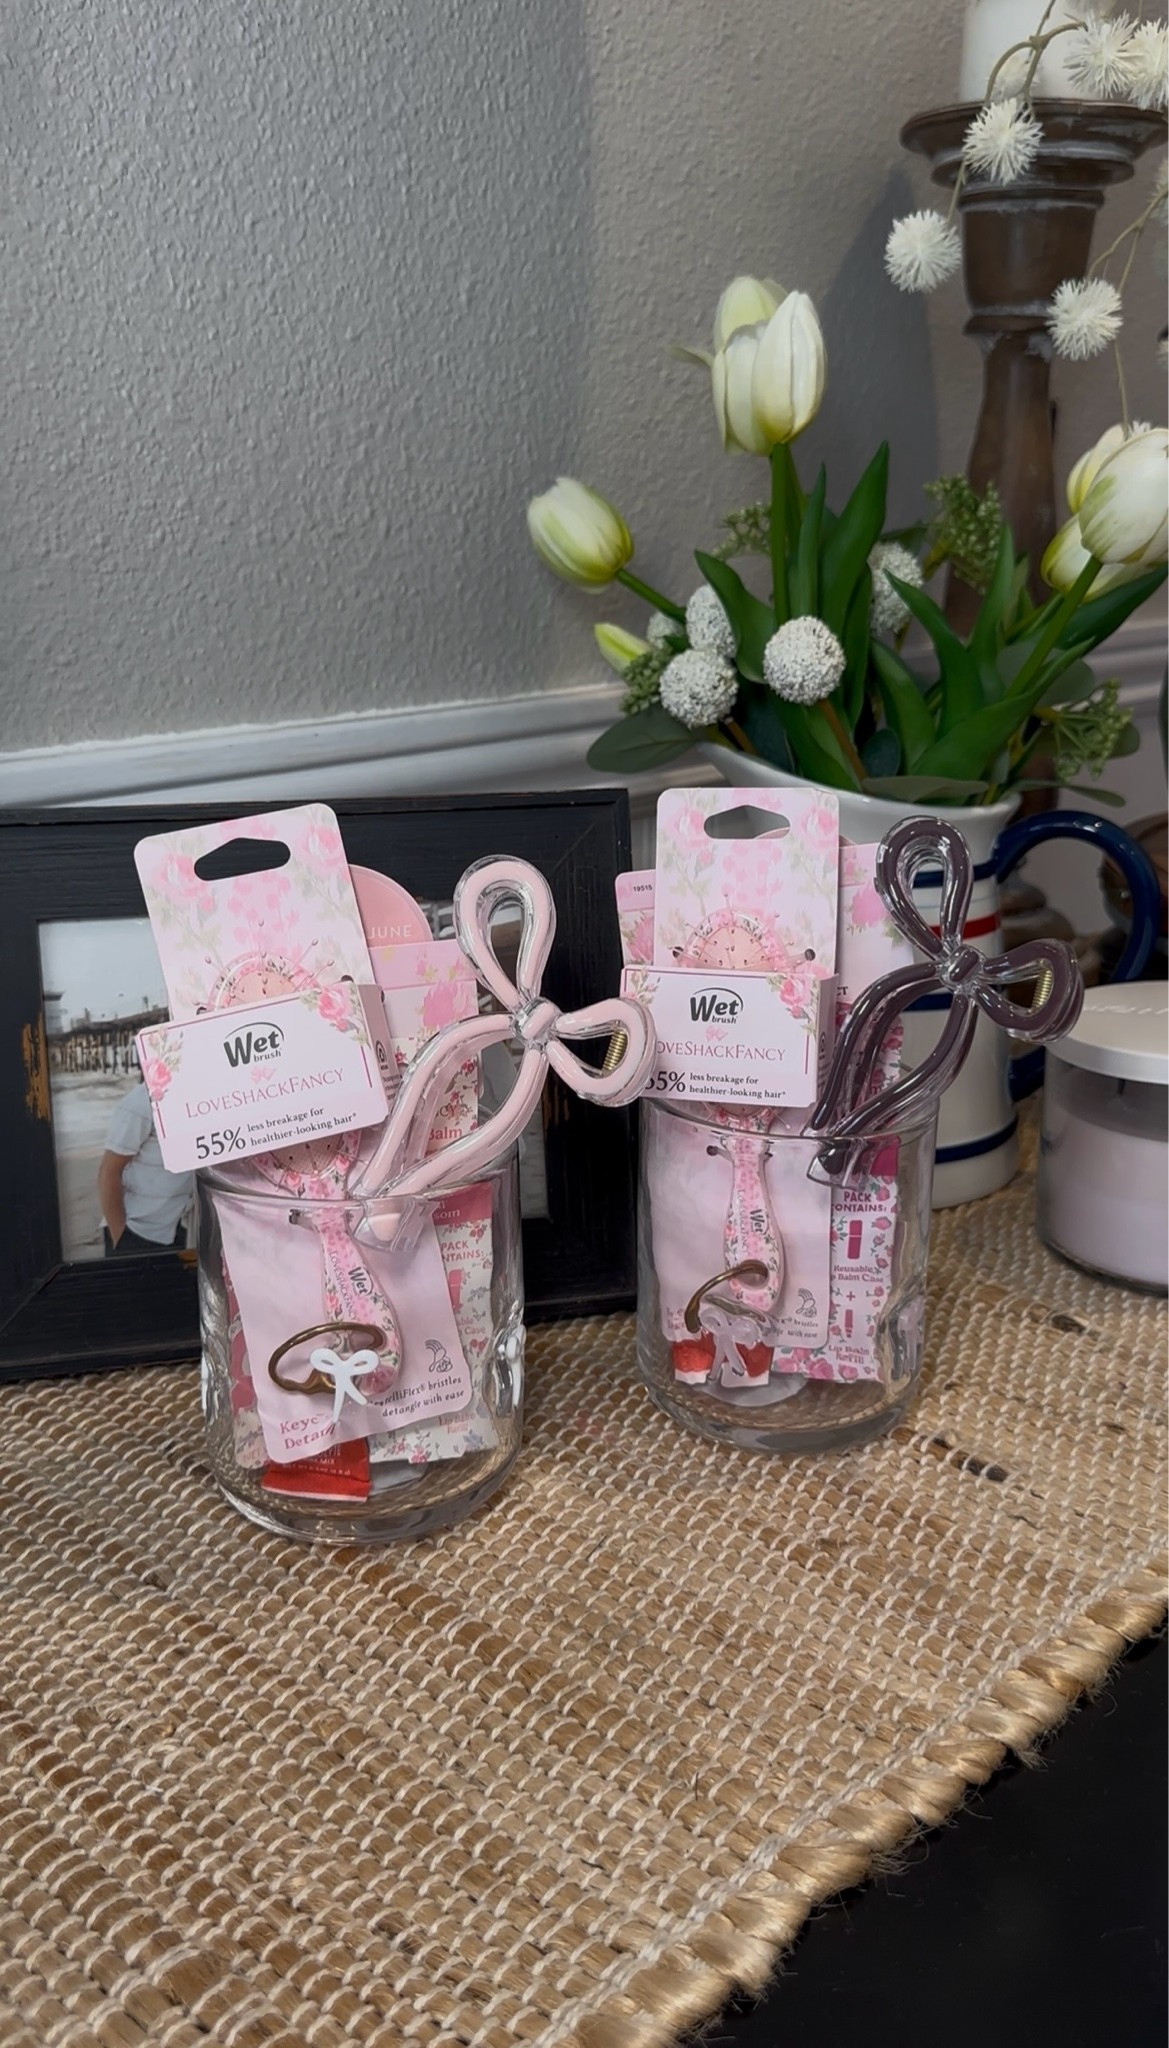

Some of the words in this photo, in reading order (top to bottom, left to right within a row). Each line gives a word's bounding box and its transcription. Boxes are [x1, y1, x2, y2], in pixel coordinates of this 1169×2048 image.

[368, 924, 413, 940] JUNE
[690, 994, 740, 1022] Wet
[711, 1015, 738, 1024] brush
[223, 1030, 281, 1068] Wet
[253, 1050, 282, 1063] brush
[656, 1040, 786, 1062] OVESHACKFANCY
[690, 1072, 705, 1082] less
[706, 1073, 744, 1085] breakage
[745, 1076, 759, 1085] for
[185, 1067, 345, 1119] LOVESHACKFANCY
[689, 1085, 762, 1100] healthier-looking
[195, 1126, 247, 1160] 55%
[247, 1123, 264, 1133] less
[265, 1111, 309, 1129] breakage
[309, 1106, 325, 1118] for
[250, 1120, 333, 1147] healthier-looking
[844, 1191, 872, 1202] PACK
[441, 1240, 469, 1252] PACK
[428, 1376, 462, 1390] bristles
[382, 1400, 421, 1417] detangle
[423, 1393, 442, 1406] with
[445, 1390, 465, 1401] ease
